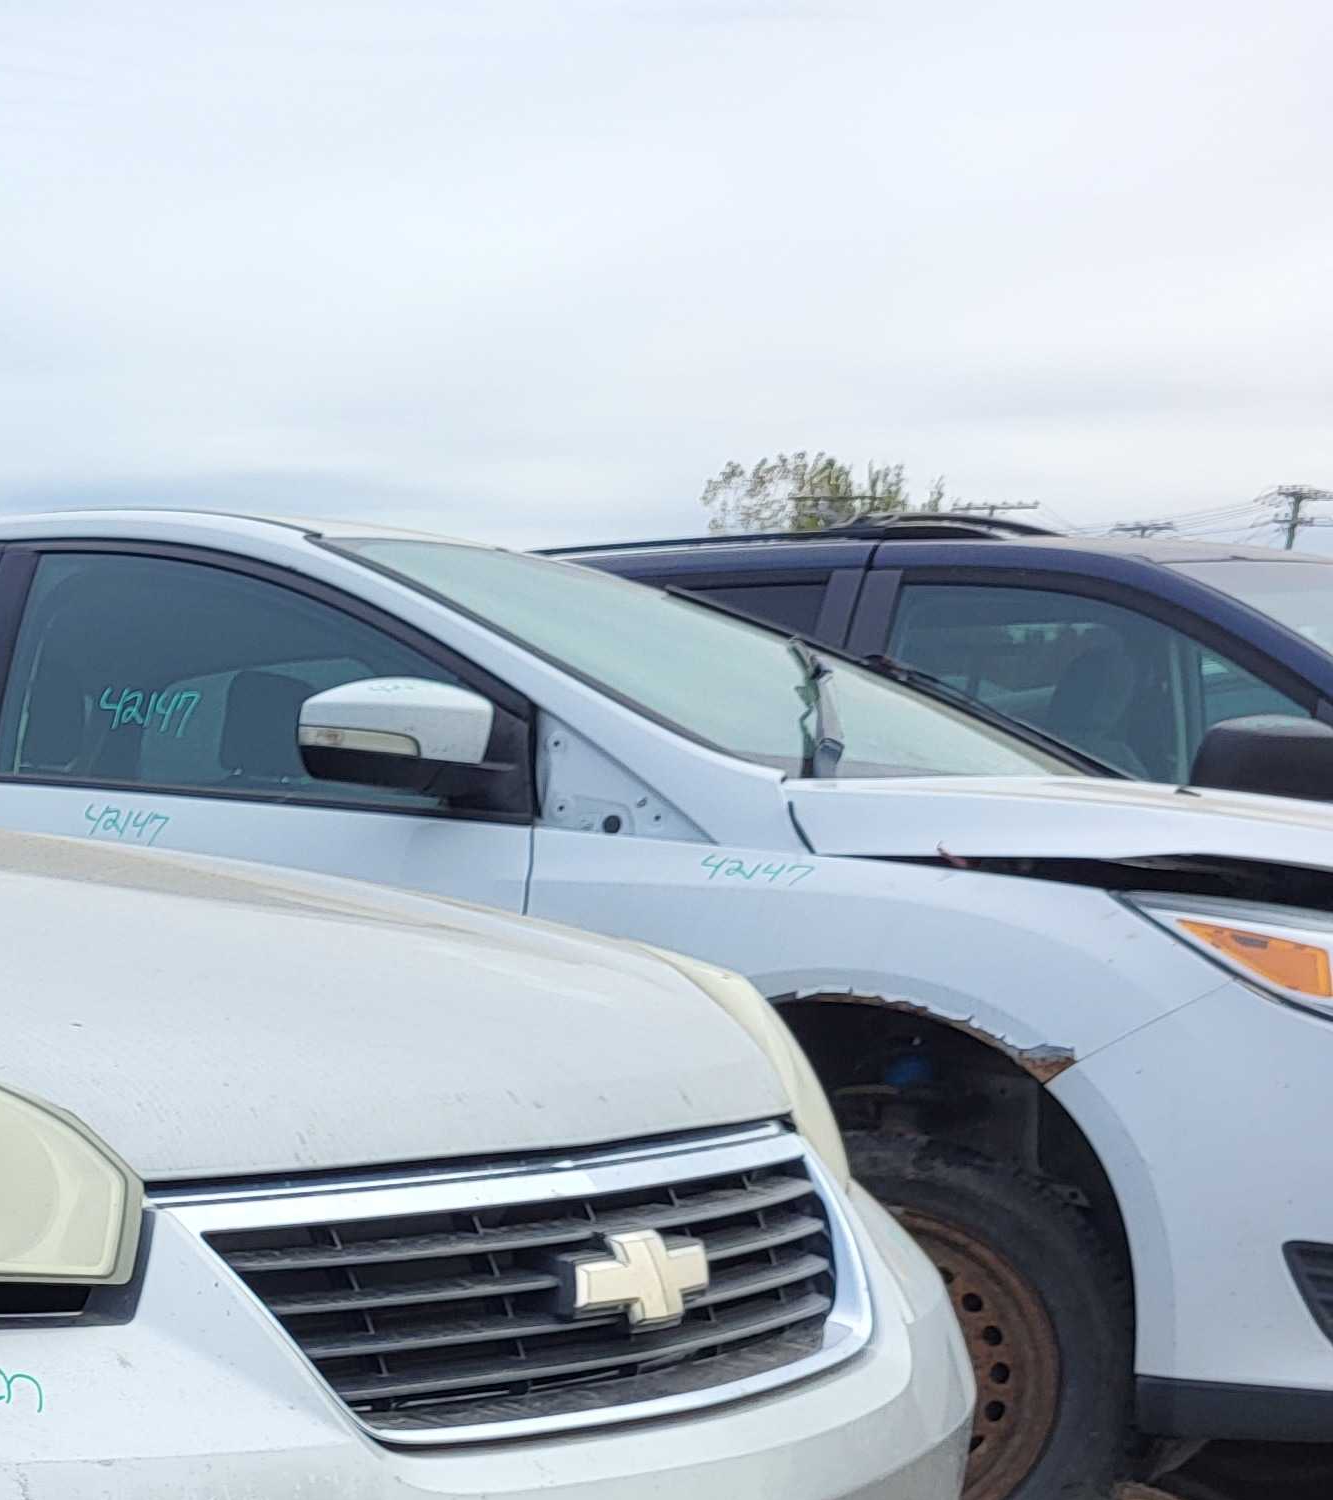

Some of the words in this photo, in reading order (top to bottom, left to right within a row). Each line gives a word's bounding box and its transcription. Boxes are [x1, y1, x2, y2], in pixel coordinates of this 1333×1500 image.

[99, 686, 201, 738] 42147
[84, 803, 170, 846] 42147
[700, 854, 815, 887] 42147
